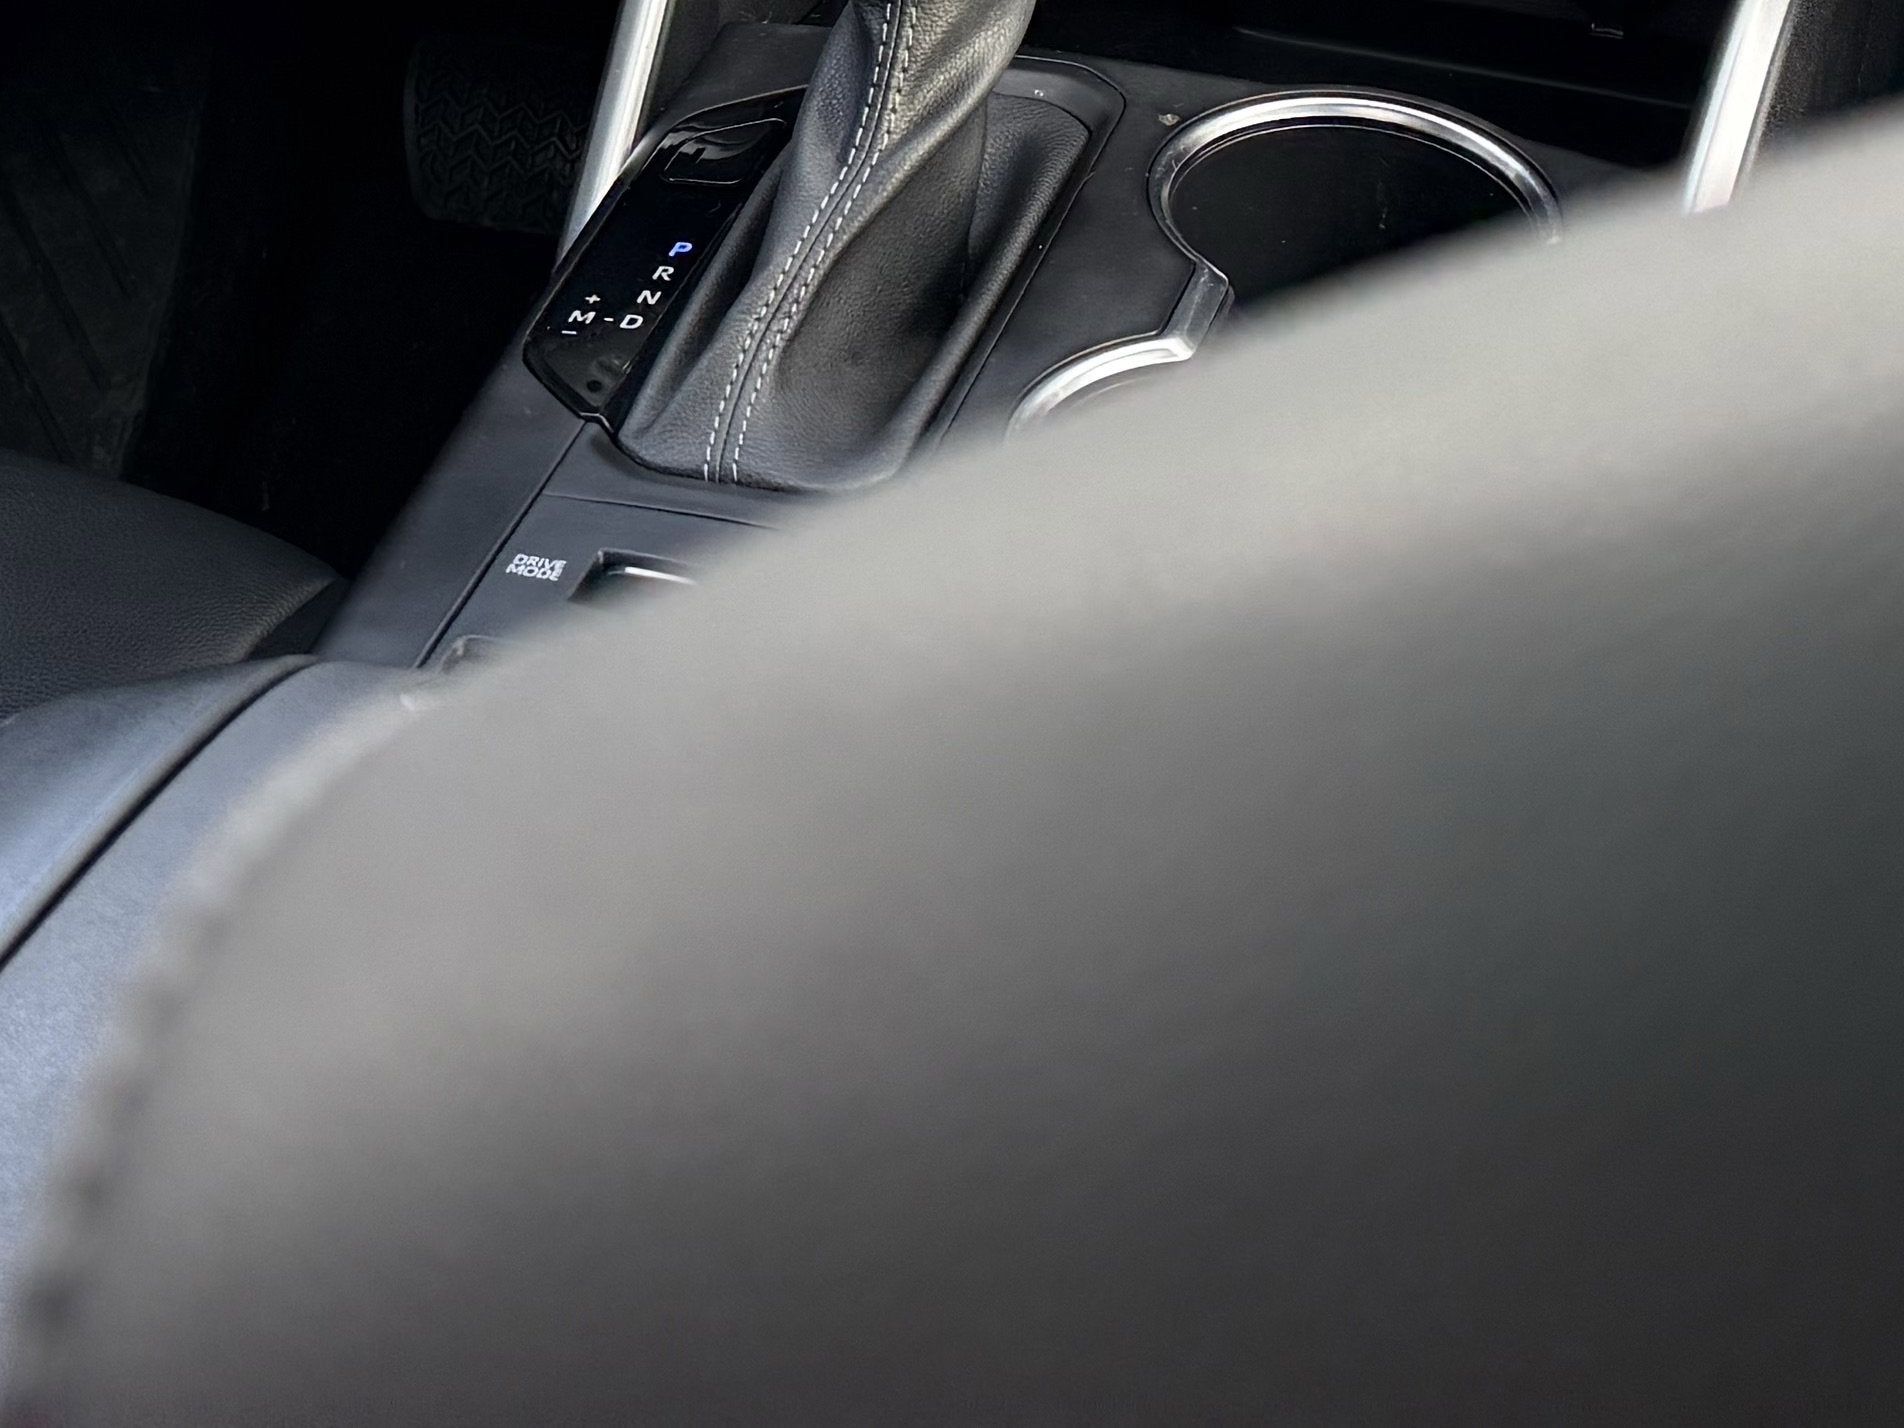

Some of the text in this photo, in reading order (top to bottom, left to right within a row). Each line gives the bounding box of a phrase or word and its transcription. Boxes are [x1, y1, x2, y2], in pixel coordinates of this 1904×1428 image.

[669, 241, 693, 257] P
[652, 265, 675, 281] R
[636, 290, 662, 305] N
[567, 309, 644, 329] M D
[512, 553, 567, 571] DRIVE
[506, 563, 562, 581] MODE
